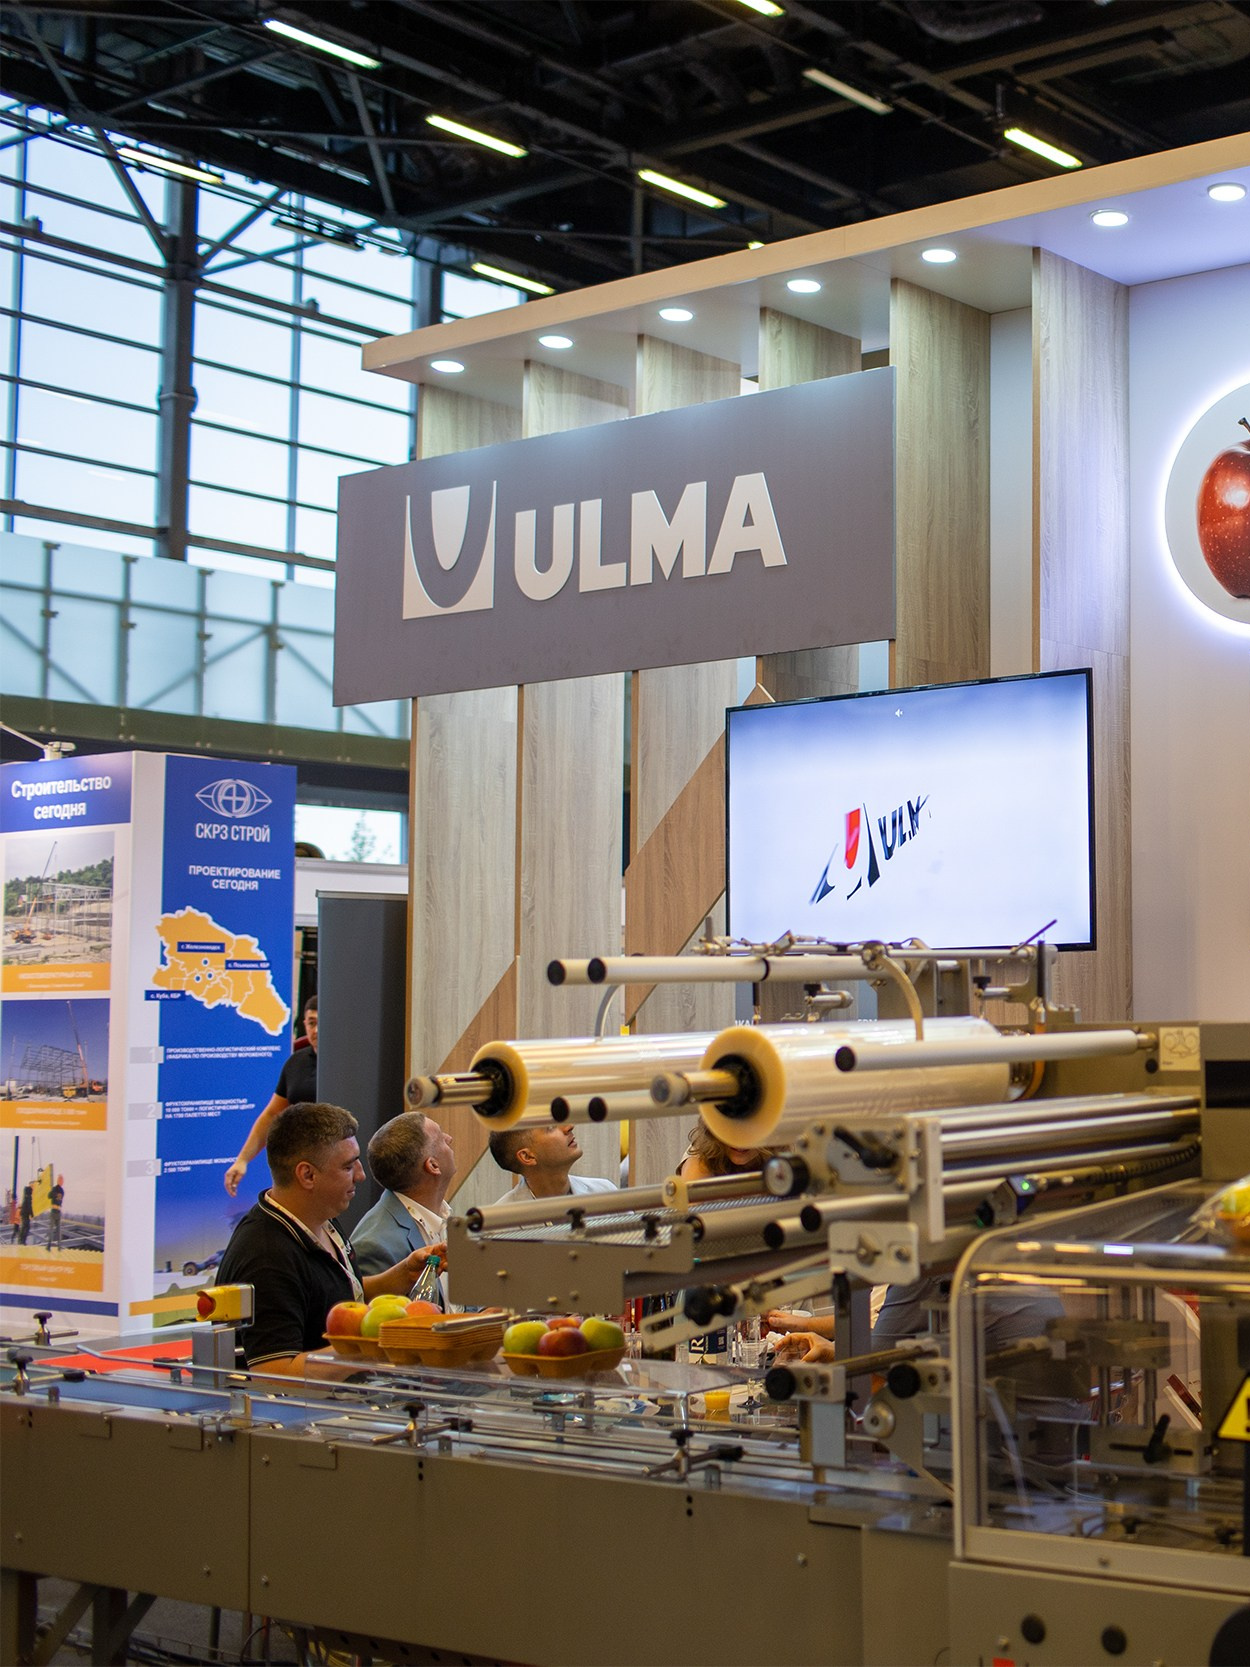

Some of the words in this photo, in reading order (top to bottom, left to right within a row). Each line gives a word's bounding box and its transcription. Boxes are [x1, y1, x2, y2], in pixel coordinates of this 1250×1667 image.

[514, 472, 788, 601] ULMA
[11, 776, 112, 801] Строительство
[34, 802, 87, 820] сегодня
[231, 824, 271, 843] СТРОЙ
[188, 865, 281, 880] ПРОЕКТИРОВАНИЕ
[211, 879, 259, 892] СЕГОДНЯ
